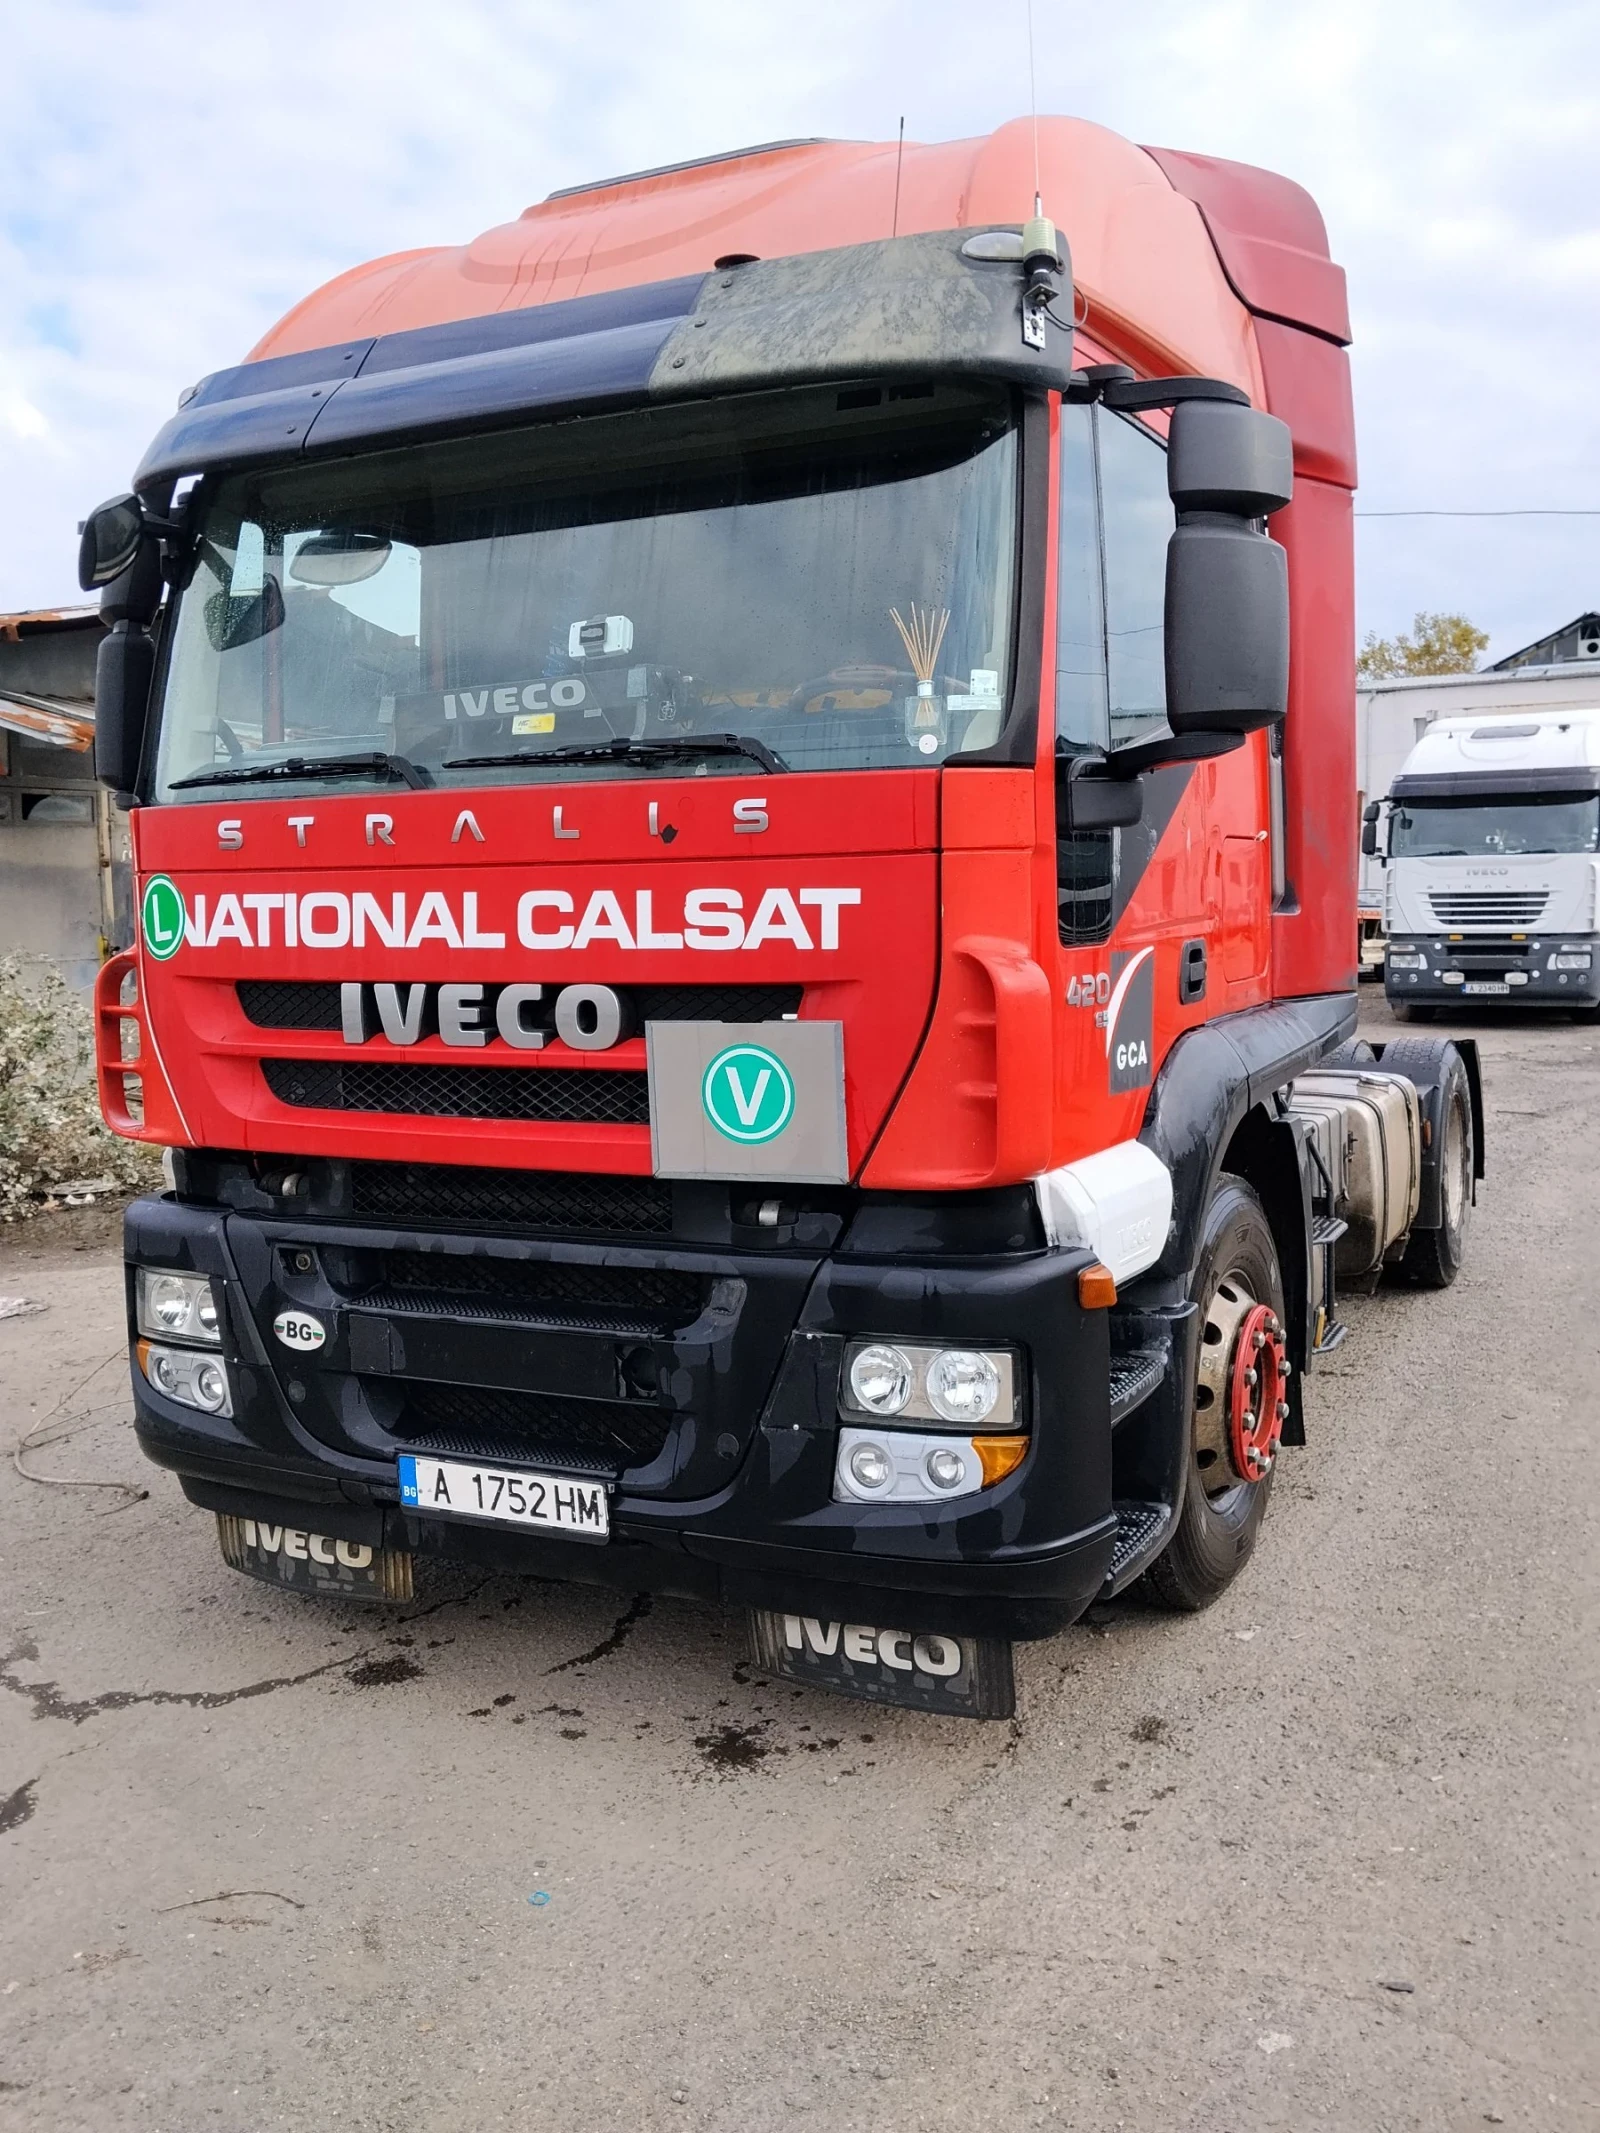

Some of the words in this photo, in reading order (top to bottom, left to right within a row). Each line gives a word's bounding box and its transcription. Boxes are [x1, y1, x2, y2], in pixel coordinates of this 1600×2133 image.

[443, 679, 586, 720] IVECO
[217, 797, 769, 850] STRALIS
[1466, 868, 1509, 876] IVECO
[152, 893, 173, 942] L
[184, 891, 505, 949] NATIONAL
[517, 888, 862, 950] CALSAT
[1067, 972, 1110, 1008] 420
[340, 982, 621, 1051] IVECO
[1116, 1040, 1148, 1070] GCA
[725, 1066, 773, 1126] V
[286, 1320, 312, 1342] BG
[404, 1485, 417, 1497] BG
[434, 1467, 452, 1504] A
[245, 1519, 373, 1568] IVECO
[784, 1613, 962, 1677] IVECO
